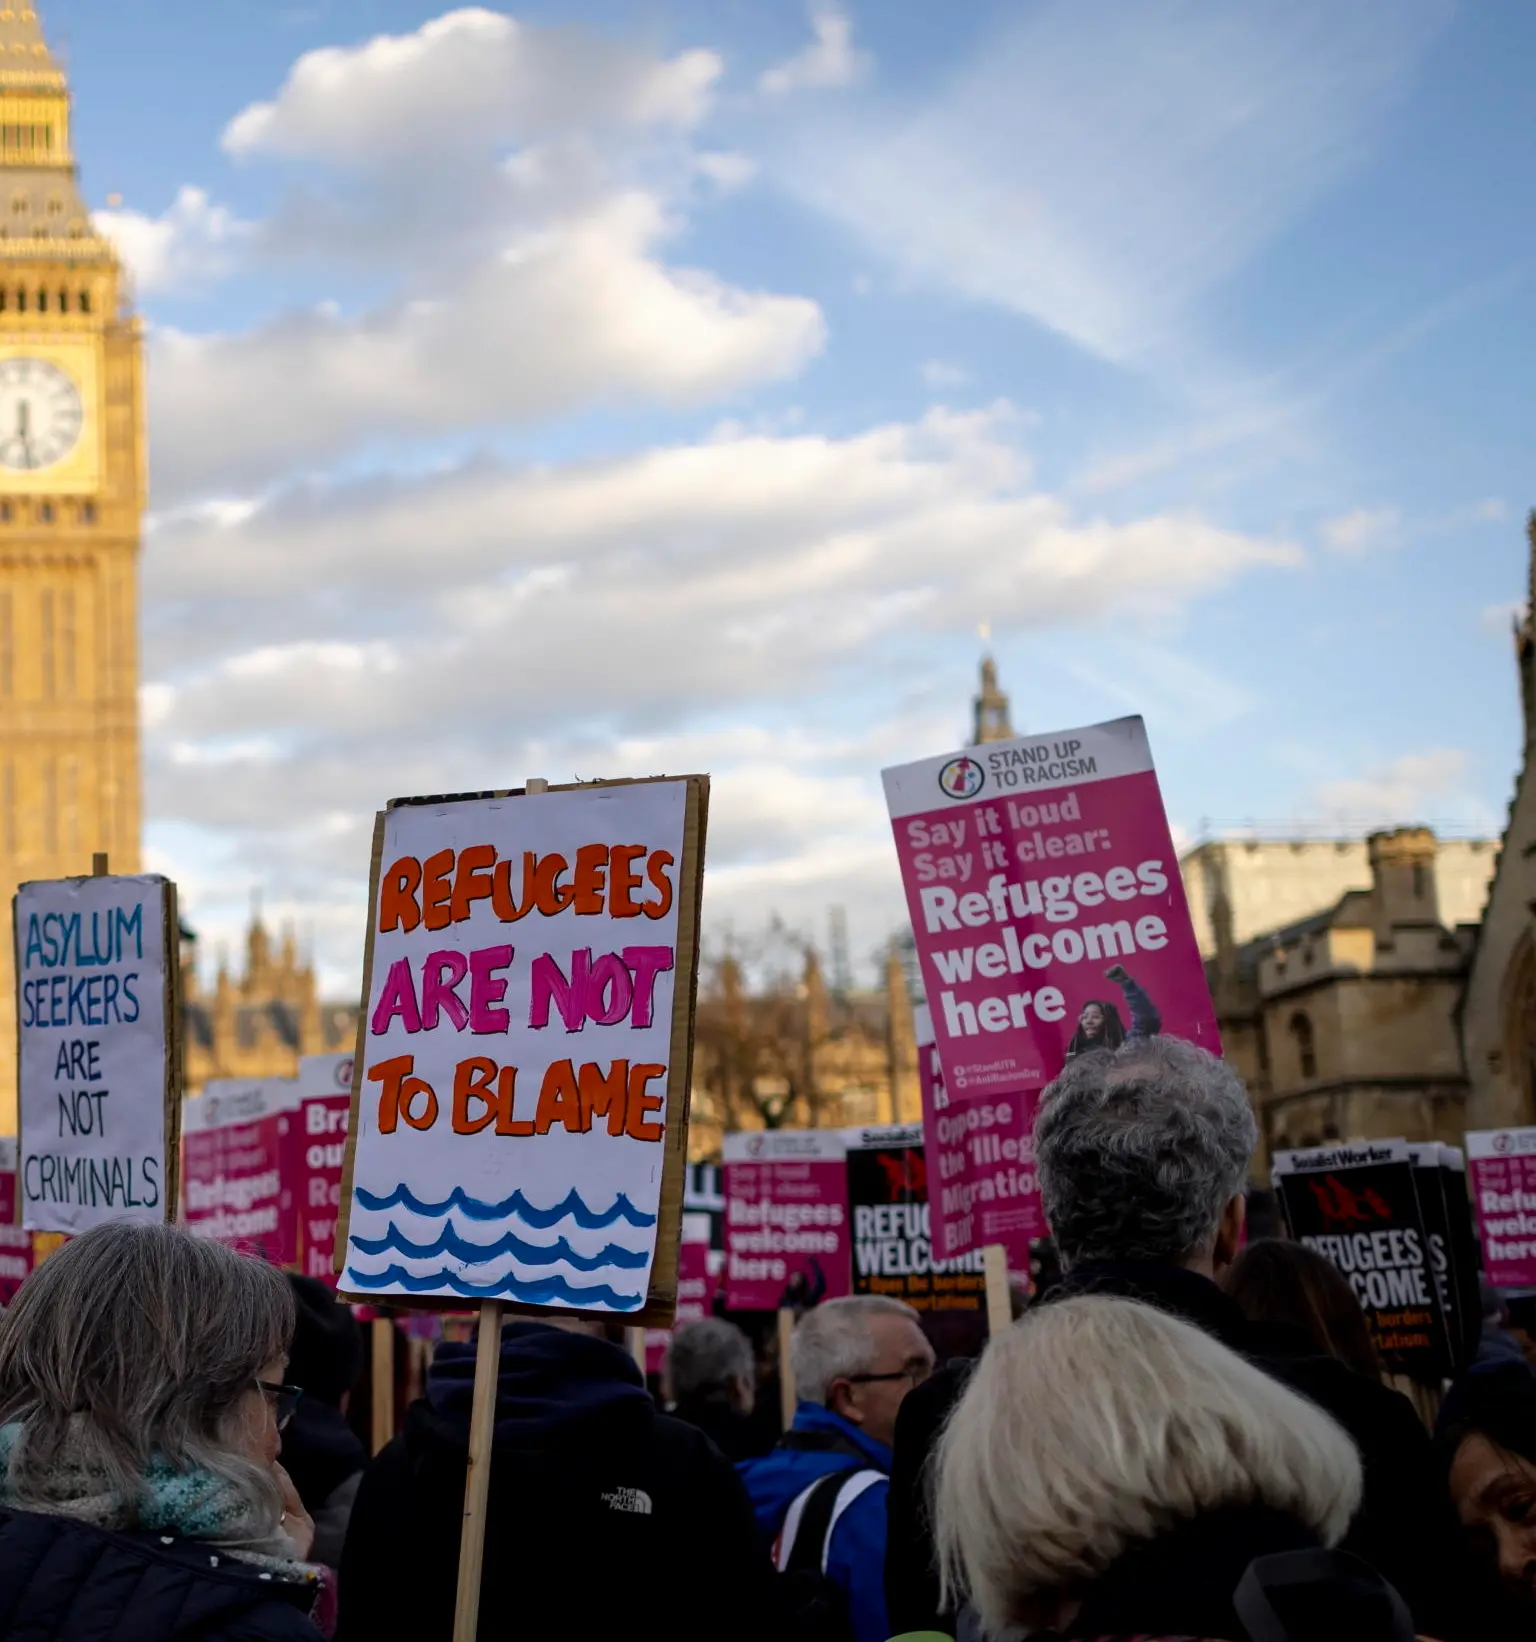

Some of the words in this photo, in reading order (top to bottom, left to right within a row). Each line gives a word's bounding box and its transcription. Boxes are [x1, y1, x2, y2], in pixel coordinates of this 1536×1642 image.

[988, 745, 1051, 770] STAND
[1055, 739, 1082, 760] UP
[994, 770, 1019, 790] TO
[1023, 757, 1098, 785] RACISM
[907, 818, 966, 849] Say
[974, 806, 1002, 837] it
[1007, 792, 1082, 830] loud
[914, 852, 973, 882] Say
[981, 840, 1010, 870] it
[1016, 827, 1112, 863] clear:
[378, 843, 675, 934] REFUGEES
[920, 860, 1168, 934] Refugees
[26, 903, 143, 969] ASYLUM
[931, 914, 1170, 985] welcome
[23, 973, 139, 1028] SEEKERS
[371, 944, 514, 1036] ARE
[528, 946, 674, 1033] NOT
[940, 985, 1067, 1038] here
[55, 1039, 102, 1081] ARE
[58, 1090, 109, 1138] NOT
[452, 1056, 667, 1142] BLAME
[938, 1102, 1013, 1145] Oppose
[24, 1155, 159, 1208] CRIMINALS
[729, 1198, 844, 1231] Refugees
[729, 1223, 839, 1254] welcome
[729, 1251, 786, 1281] here
[601, 1492, 636, 1504] NORTH
[609, 1500, 634, 1512] FACE
[616, 1486, 636, 1497] THE
